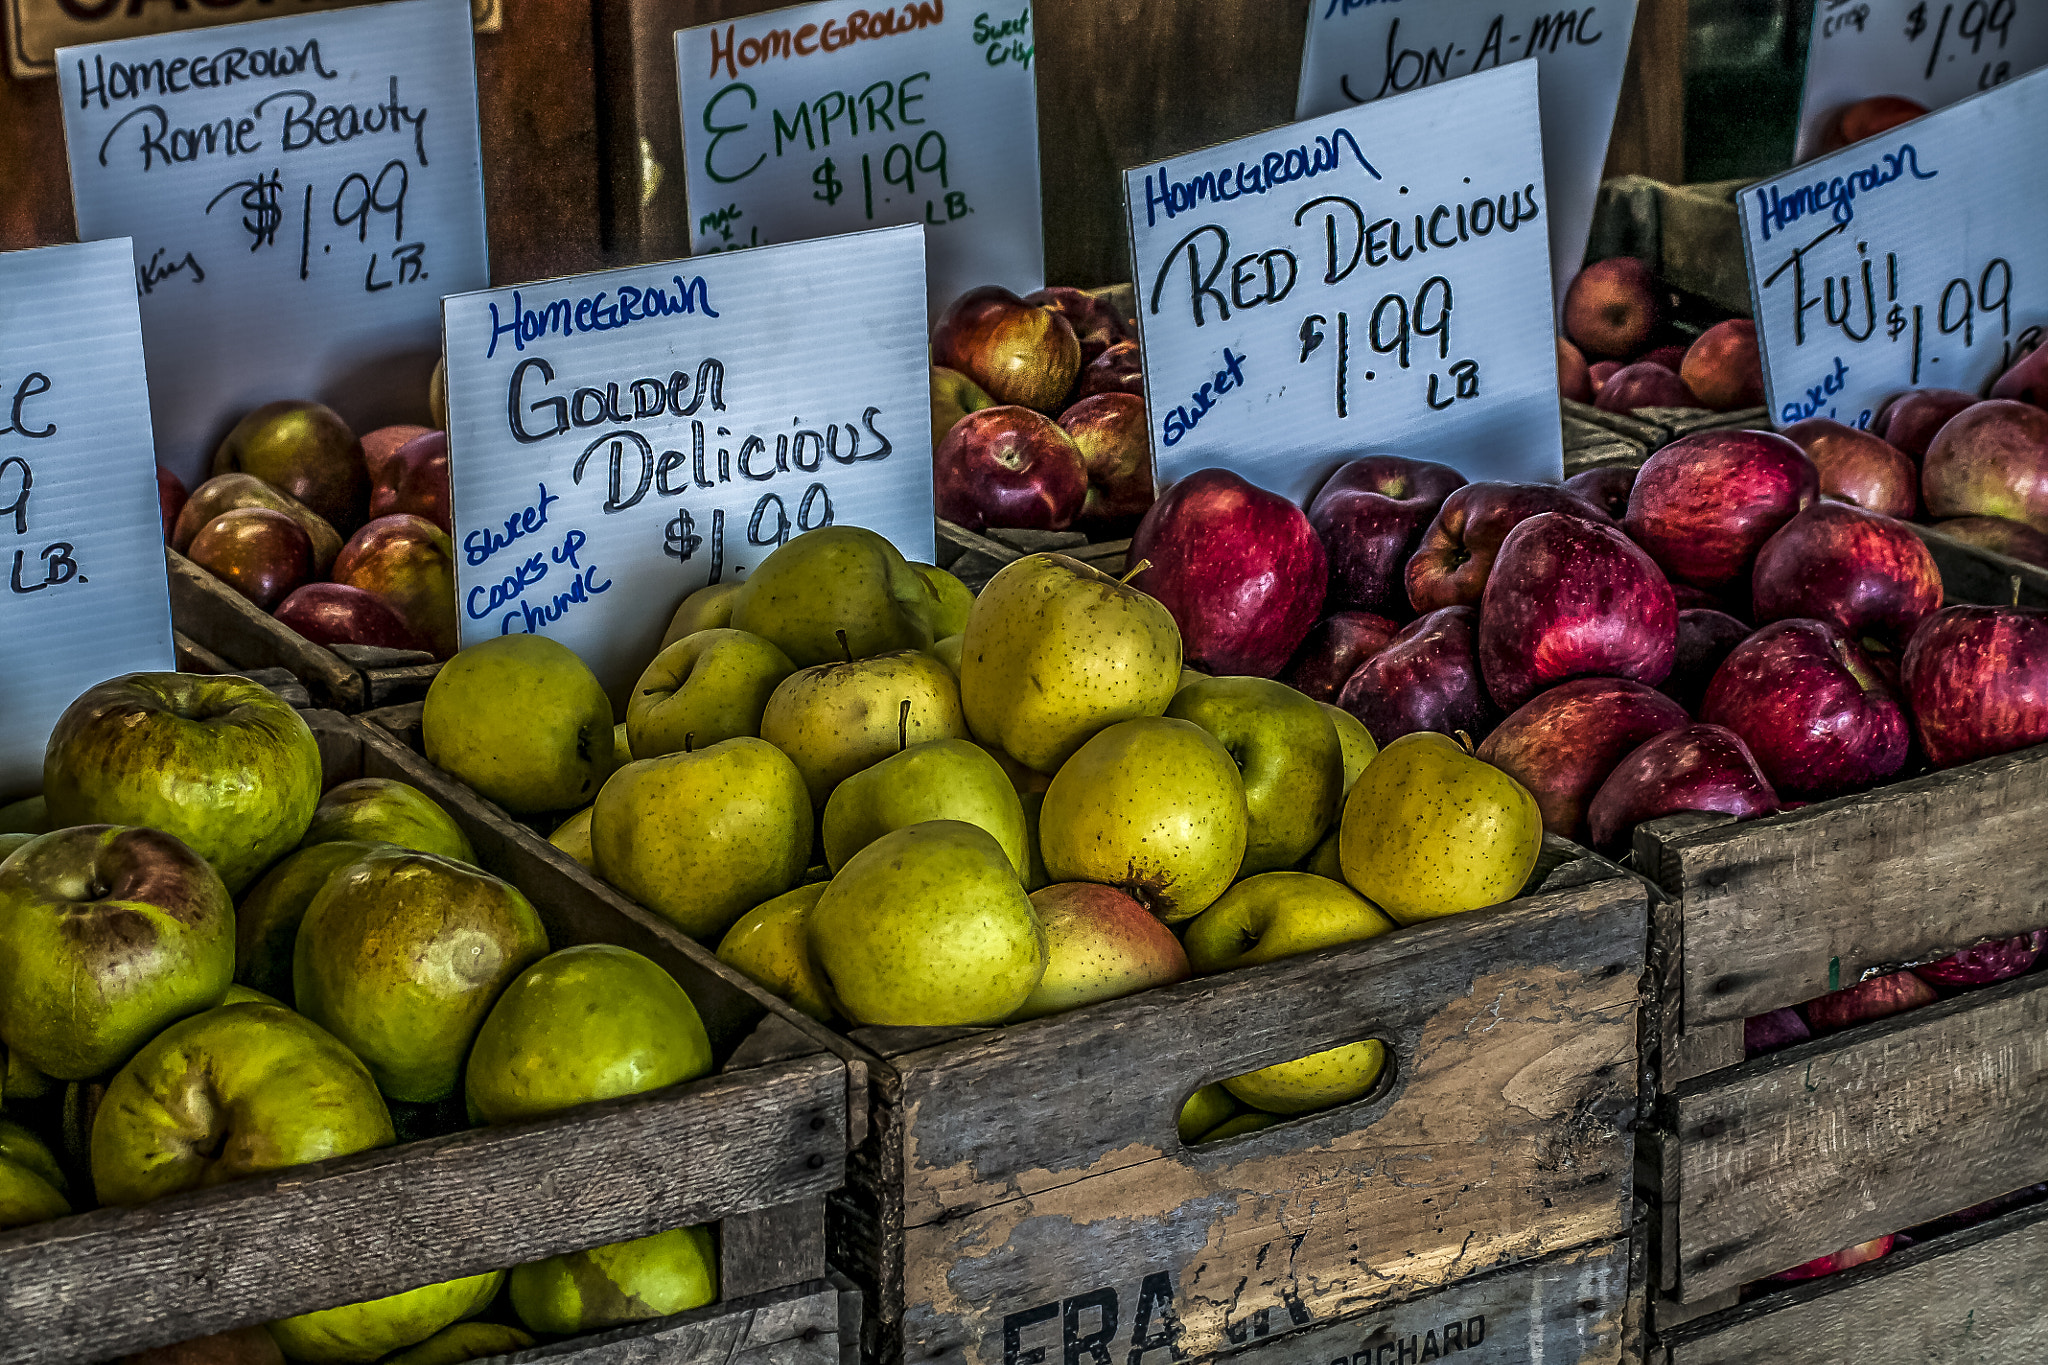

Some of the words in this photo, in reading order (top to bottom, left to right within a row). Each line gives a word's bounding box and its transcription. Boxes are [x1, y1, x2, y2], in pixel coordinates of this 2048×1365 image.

[1904, 0, 2016, 80] $1.99
[99, 104, 262, 171] Rome
[254, 75, 429, 167] Beauty
[703, 71, 932, 183] EMPIRE
[206, 159, 408, 281] $1.99
[812, 130, 948, 219] $1.99
[926, 191, 974, 226] LB.
[365, 242, 429, 292] LB.
[1151, 223, 1298, 328] RED
[1294, 176, 1540, 285] DELICIOUS
[1299, 275, 1453, 418] $1.99
[1886, 258, 2012, 384] $1.99
[1426, 359, 1480, 410] LB
[572, 405, 893, 515] Delicious
[10, 542, 89, 594] LB.
